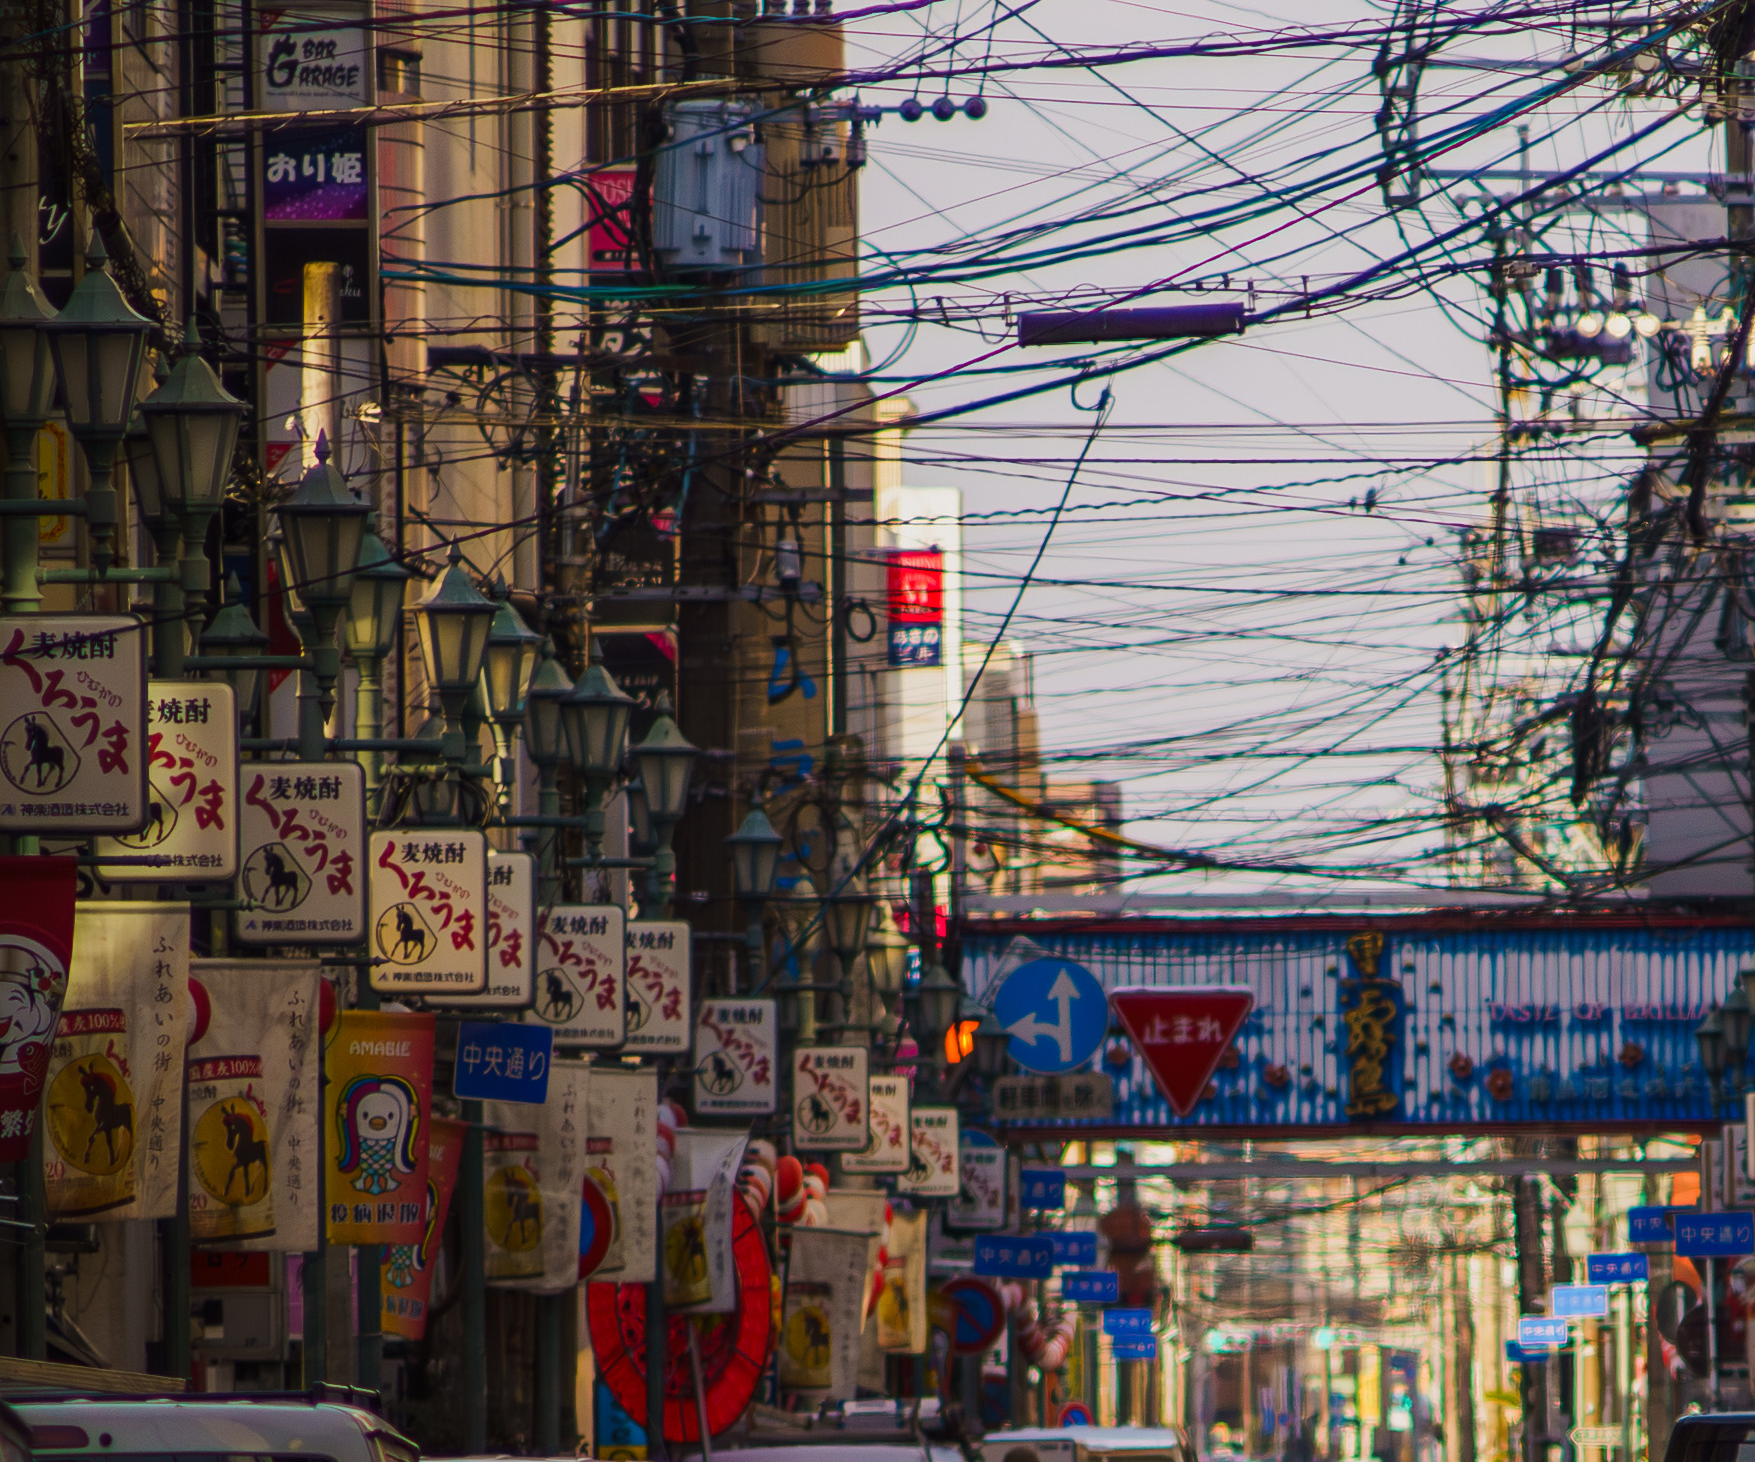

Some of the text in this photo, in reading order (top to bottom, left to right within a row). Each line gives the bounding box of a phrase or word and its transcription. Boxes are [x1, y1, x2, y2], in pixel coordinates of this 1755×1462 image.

[301, 38, 337, 60] BAR
[266, 150, 363, 185] おり姫
[31, 631, 118, 660] 麦焼酎
[3, 628, 130, 776] くろうま
[76, 670, 123, 709] ひむかの
[176, 733, 218, 768] ひむかの
[270, 775, 342, 801] 麦焼酎
[21, 801, 130, 818] 神楽酒造株式会社
[245, 773, 355, 896] くろうま
[402, 841, 467, 865] 麦焼酎
[378, 840, 476, 952] くろうま
[262, 919, 354, 932] 神楽酒造株式会社
[552, 915, 609, 936] 麦焼酎
[1142, 1013, 1224, 1045] 止まれ
[146, 936, 176, 1172] ふれあいの街 中央通り
[287, 990, 306, 1114] ふれあいの街
[349, 1040, 412, 1058] AMABIE
[462, 1044, 546, 1081] 中央通り
[1681, 1224, 1751, 1244] 中央通り
[979, 1245, 1049, 1268] 中央通り
[1591, 1260, 1646, 1276] 中央通り
